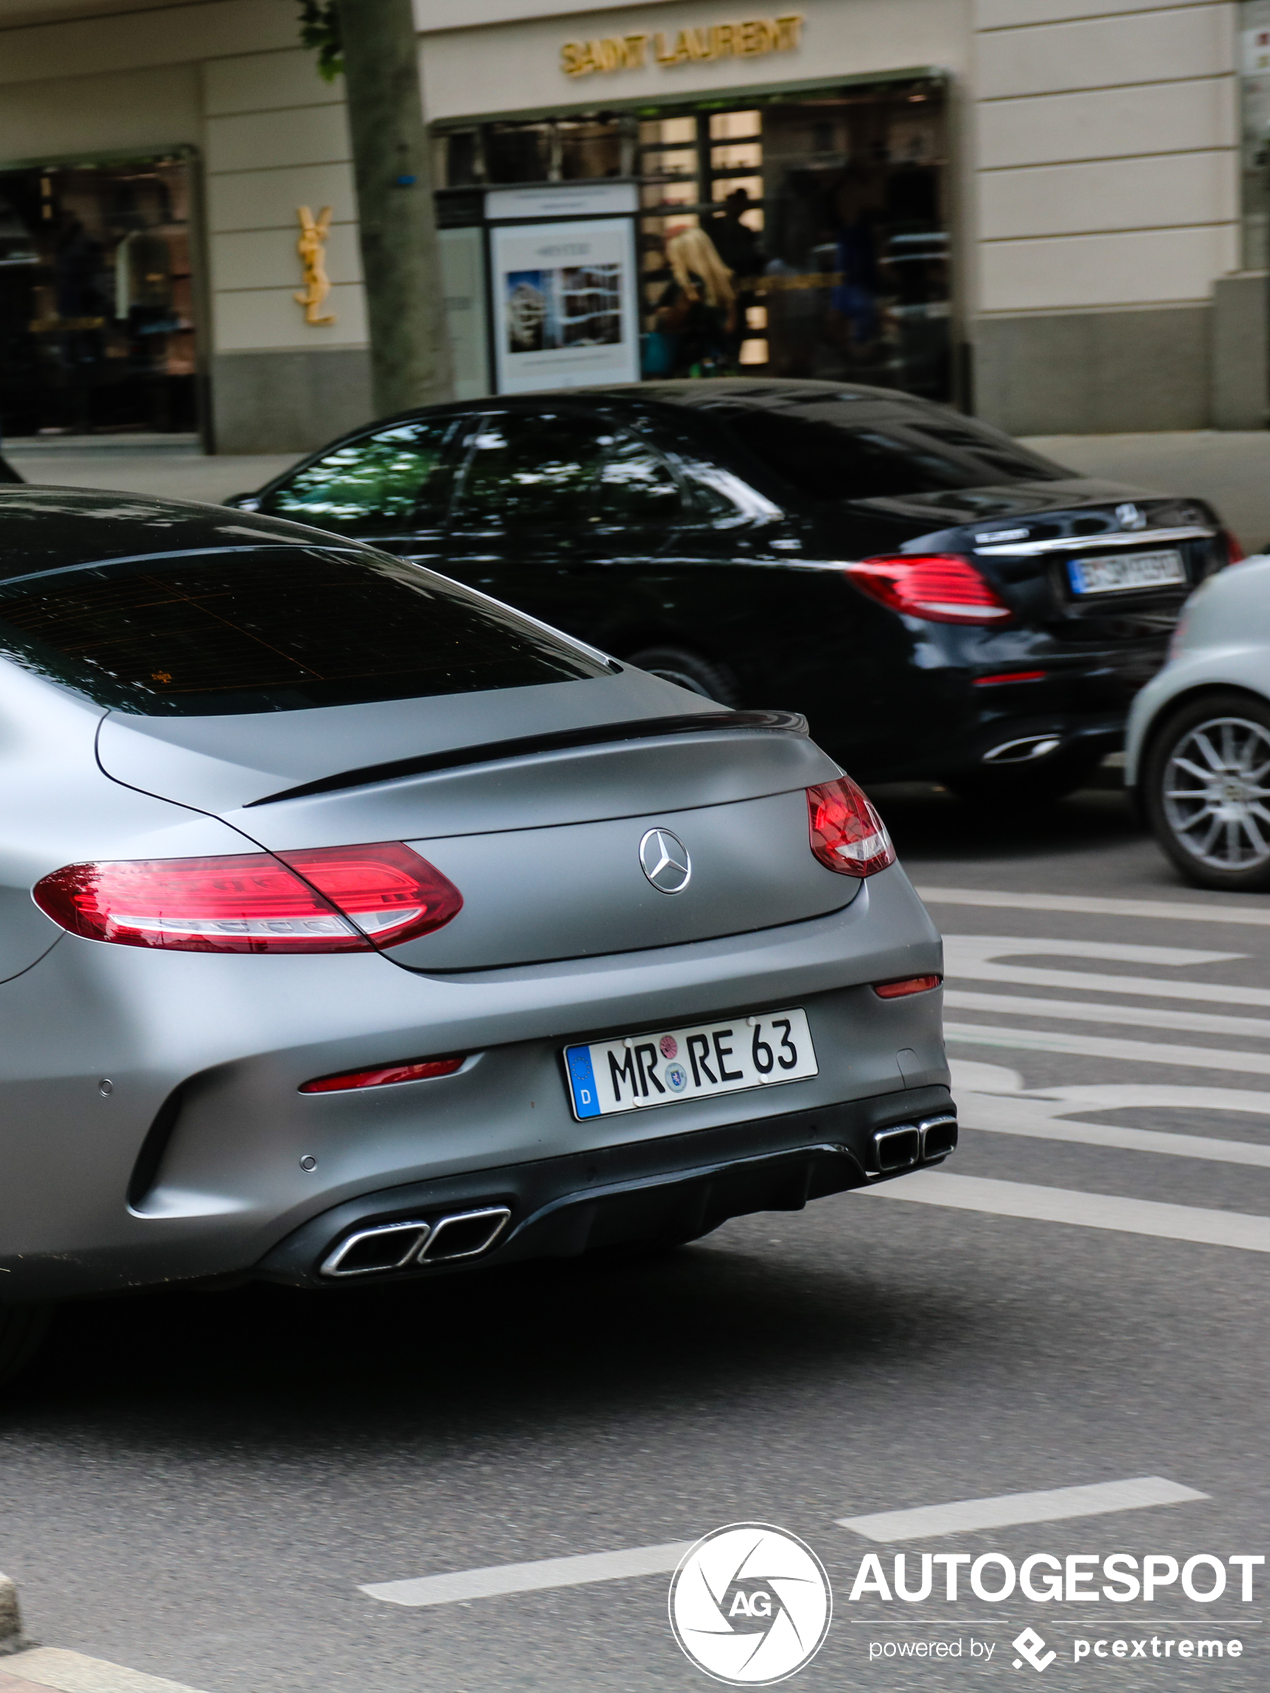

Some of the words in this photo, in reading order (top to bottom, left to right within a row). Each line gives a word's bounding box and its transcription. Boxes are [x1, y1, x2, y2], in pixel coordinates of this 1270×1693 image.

[561, 35, 647, 77] SAINT
[654, 15, 804, 67] LAURENT
[607, 1042, 666, 1102] MR
[686, 1029, 744, 1087] RE
[751, 1018, 798, 1075] 63
[580, 1089, 592, 1104] D
